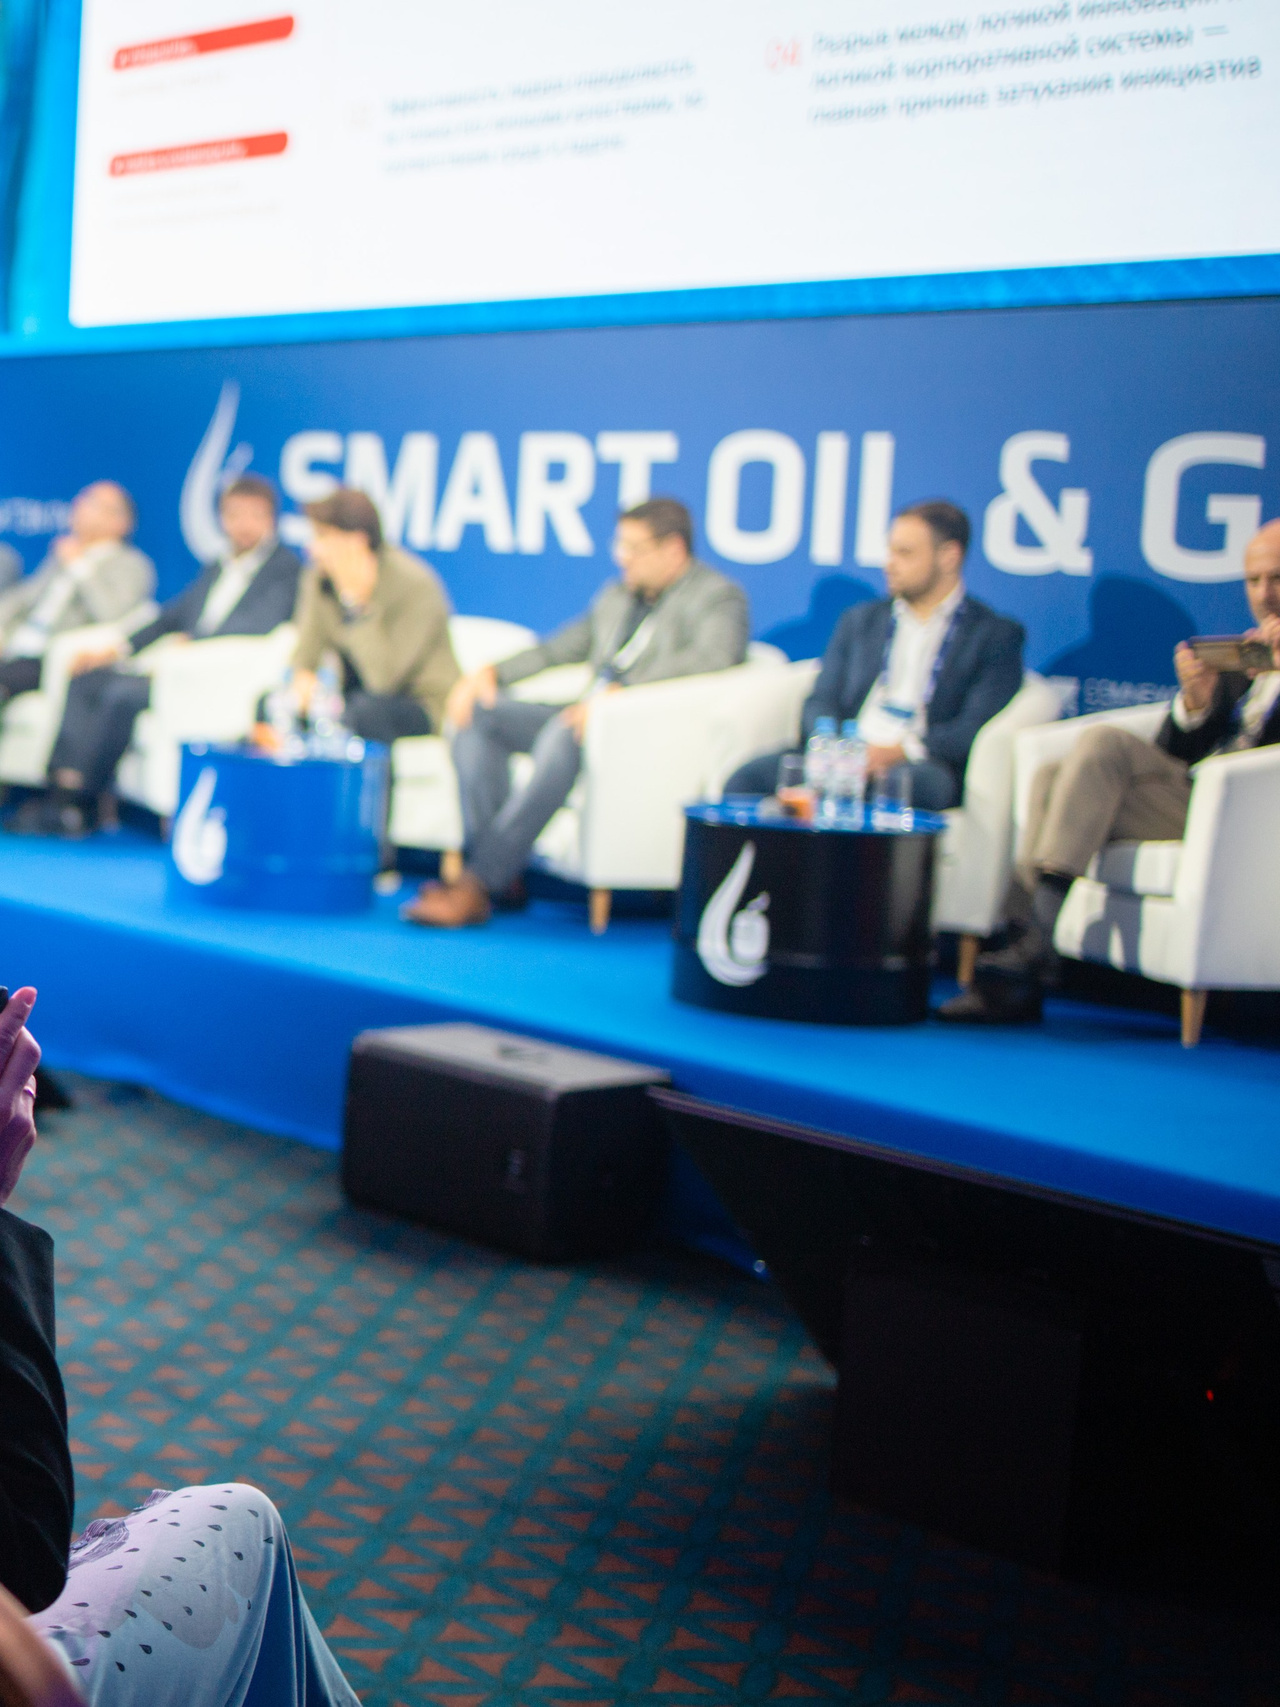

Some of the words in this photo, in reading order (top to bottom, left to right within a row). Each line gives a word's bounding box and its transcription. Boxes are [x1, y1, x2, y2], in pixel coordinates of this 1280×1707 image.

[280, 430, 679, 556] SMART
[706, 428, 898, 568] OIL
[983, 430, 1092, 577] &
